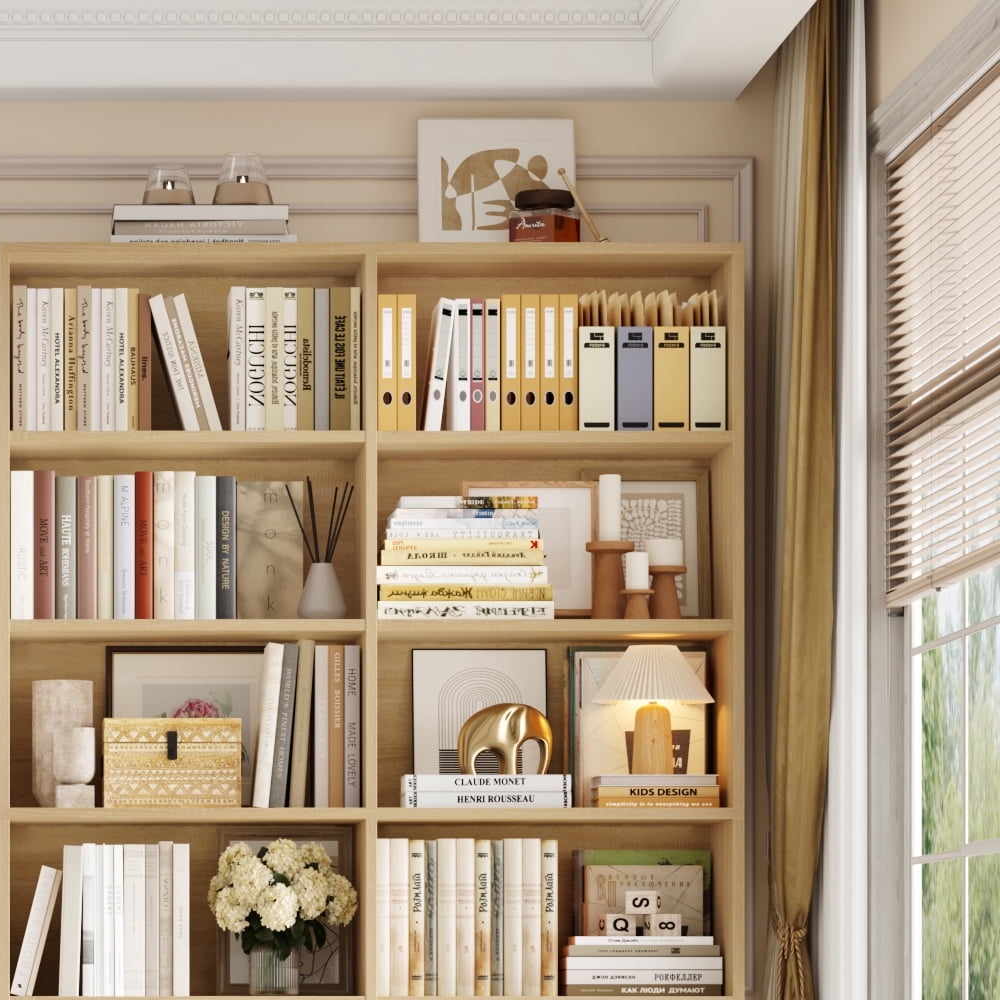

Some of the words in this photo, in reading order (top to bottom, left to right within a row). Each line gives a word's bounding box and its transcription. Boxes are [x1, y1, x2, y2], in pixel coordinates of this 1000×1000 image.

[41, 300, 50, 325] Karen
[105, 300, 114, 325] Karen
[66, 357, 75, 411] Huffington
[39, 518, 48, 543] MOVE
[61, 515, 71, 545] HAUTE
[139, 520, 147, 544] MOVE
[222, 510, 230, 541] DESIGN
[222, 544, 230, 555] BY
[39, 560, 48, 577] ART
[139, 560, 147, 577] ART
[222, 558, 230, 590] NATURE
[347, 668, 356, 696] HOME
[279, 712, 288, 742] FINEST
[347, 723, 356, 748] MADE
[276, 747, 285, 778] HOMES
[347, 754, 356, 788] LOVELY
[454, 778, 491, 786] CLAUDE
[494, 778, 526, 786] MONET
[629, 788, 654, 796] KIDS
[657, 788, 698, 796] DESIGN
[457, 795, 485, 803] HENRI
[488, 795, 535, 803] ROUSSEAU
[632, 897, 650, 908] S
[613, 918, 629, 932] Q
[659, 921, 676, 930] 8
